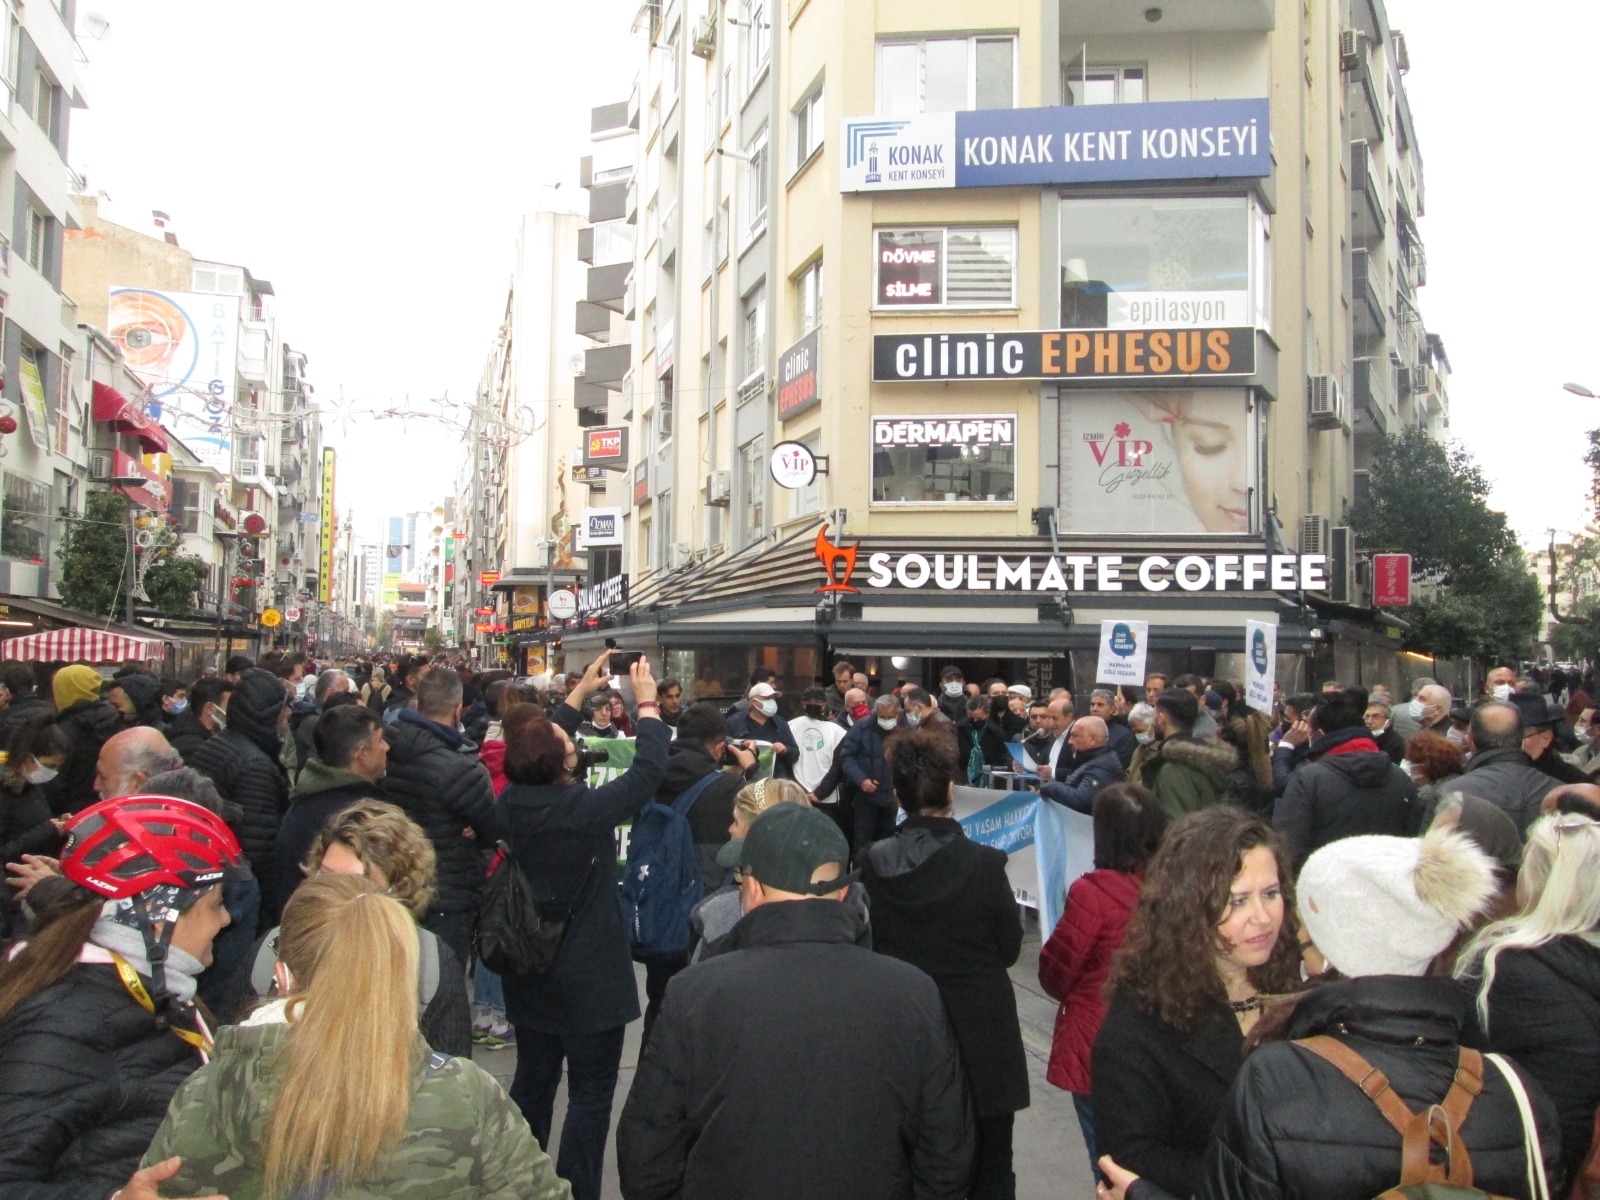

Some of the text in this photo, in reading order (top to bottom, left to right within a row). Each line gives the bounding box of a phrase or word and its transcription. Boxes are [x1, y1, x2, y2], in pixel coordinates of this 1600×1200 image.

[964, 118, 1257, 167] KONAK KENT KONSEYİ
[889, 144, 943, 166] KONAK
[889, 166, 945, 181] KENT KONSEYİ
[882, 247, 936, 264] DÖVME
[886, 280, 932, 297] SİLME
[1129, 296, 1226, 326] epilasyon
[896, 330, 1231, 377] clinic EPHESUS
[785, 347, 809, 382] clinic
[780, 370, 815, 414] EPHESUS
[601, 437, 620, 447] TKP
[875, 422, 1012, 443] DERMAPEN
[867, 552, 1327, 591] SOULMATE COFFEE
[975, 816, 1002, 837] YAŞAM
[86, 876, 119, 893] LAZER
[195, 872, 224, 882] LAZER
